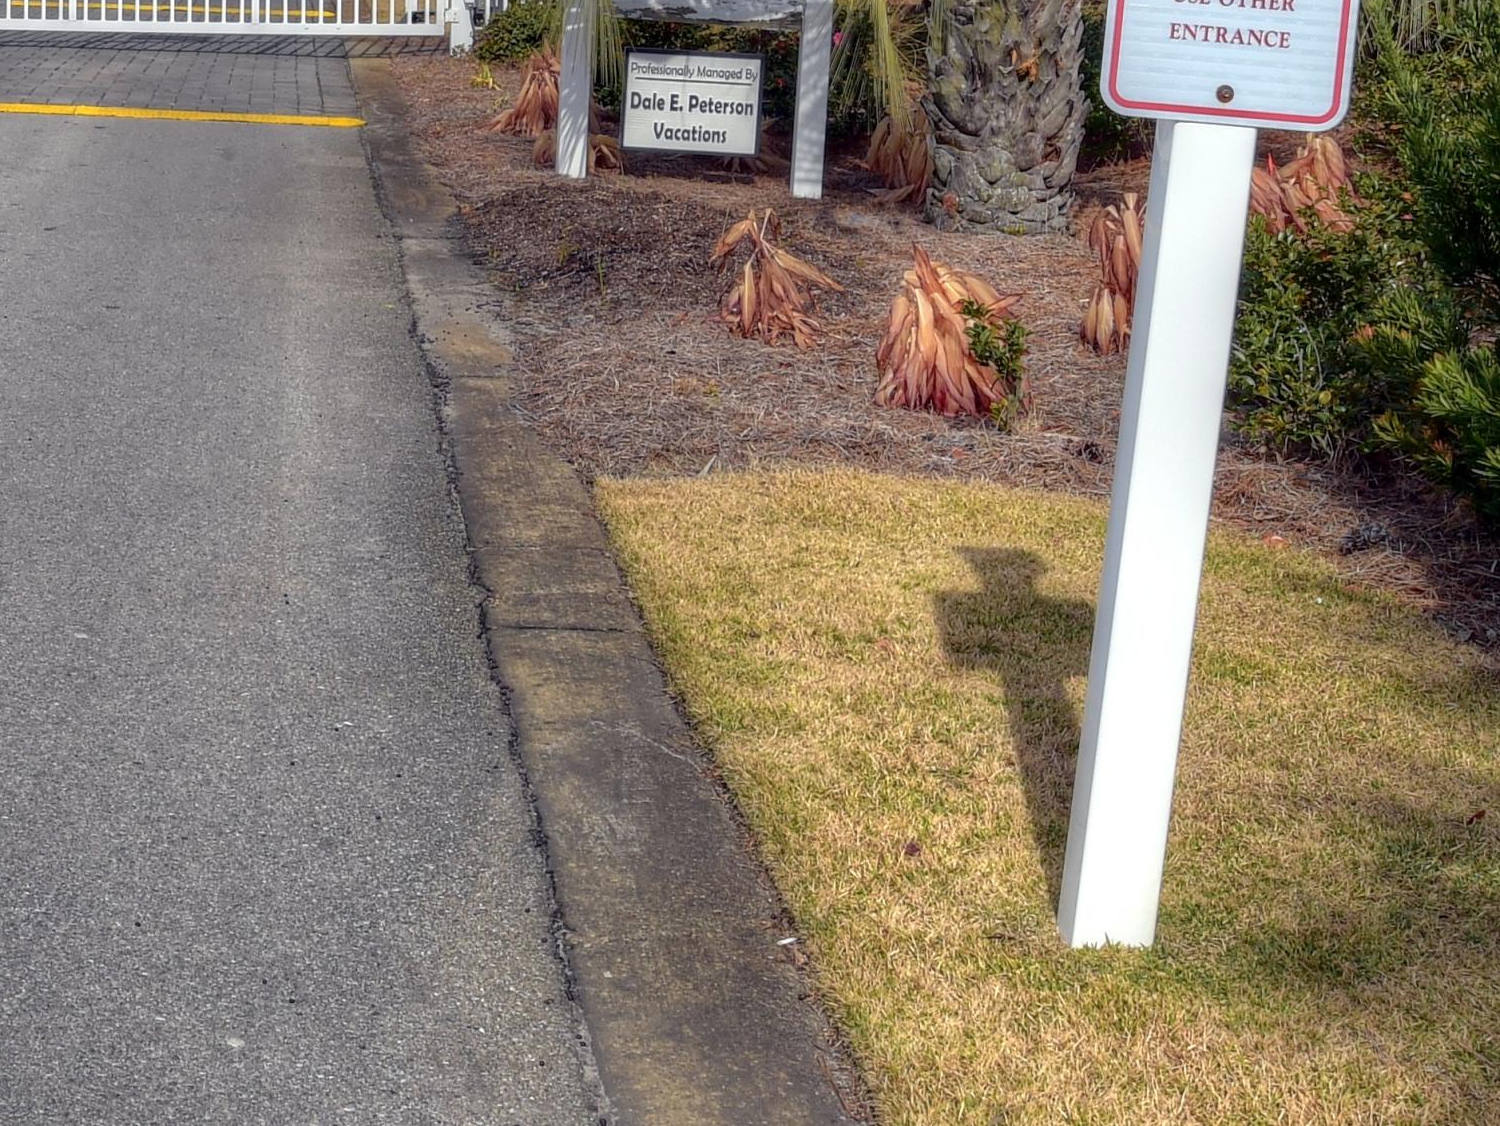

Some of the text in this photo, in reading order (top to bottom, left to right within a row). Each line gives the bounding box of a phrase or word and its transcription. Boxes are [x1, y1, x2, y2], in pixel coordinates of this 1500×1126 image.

[1169, 22, 1291, 49] ENTRANCE
[630, 61, 758, 82] Professionally Managed By
[630, 91, 754, 116] Dale E. Peterson
[653, 122, 727, 144] Vacations
